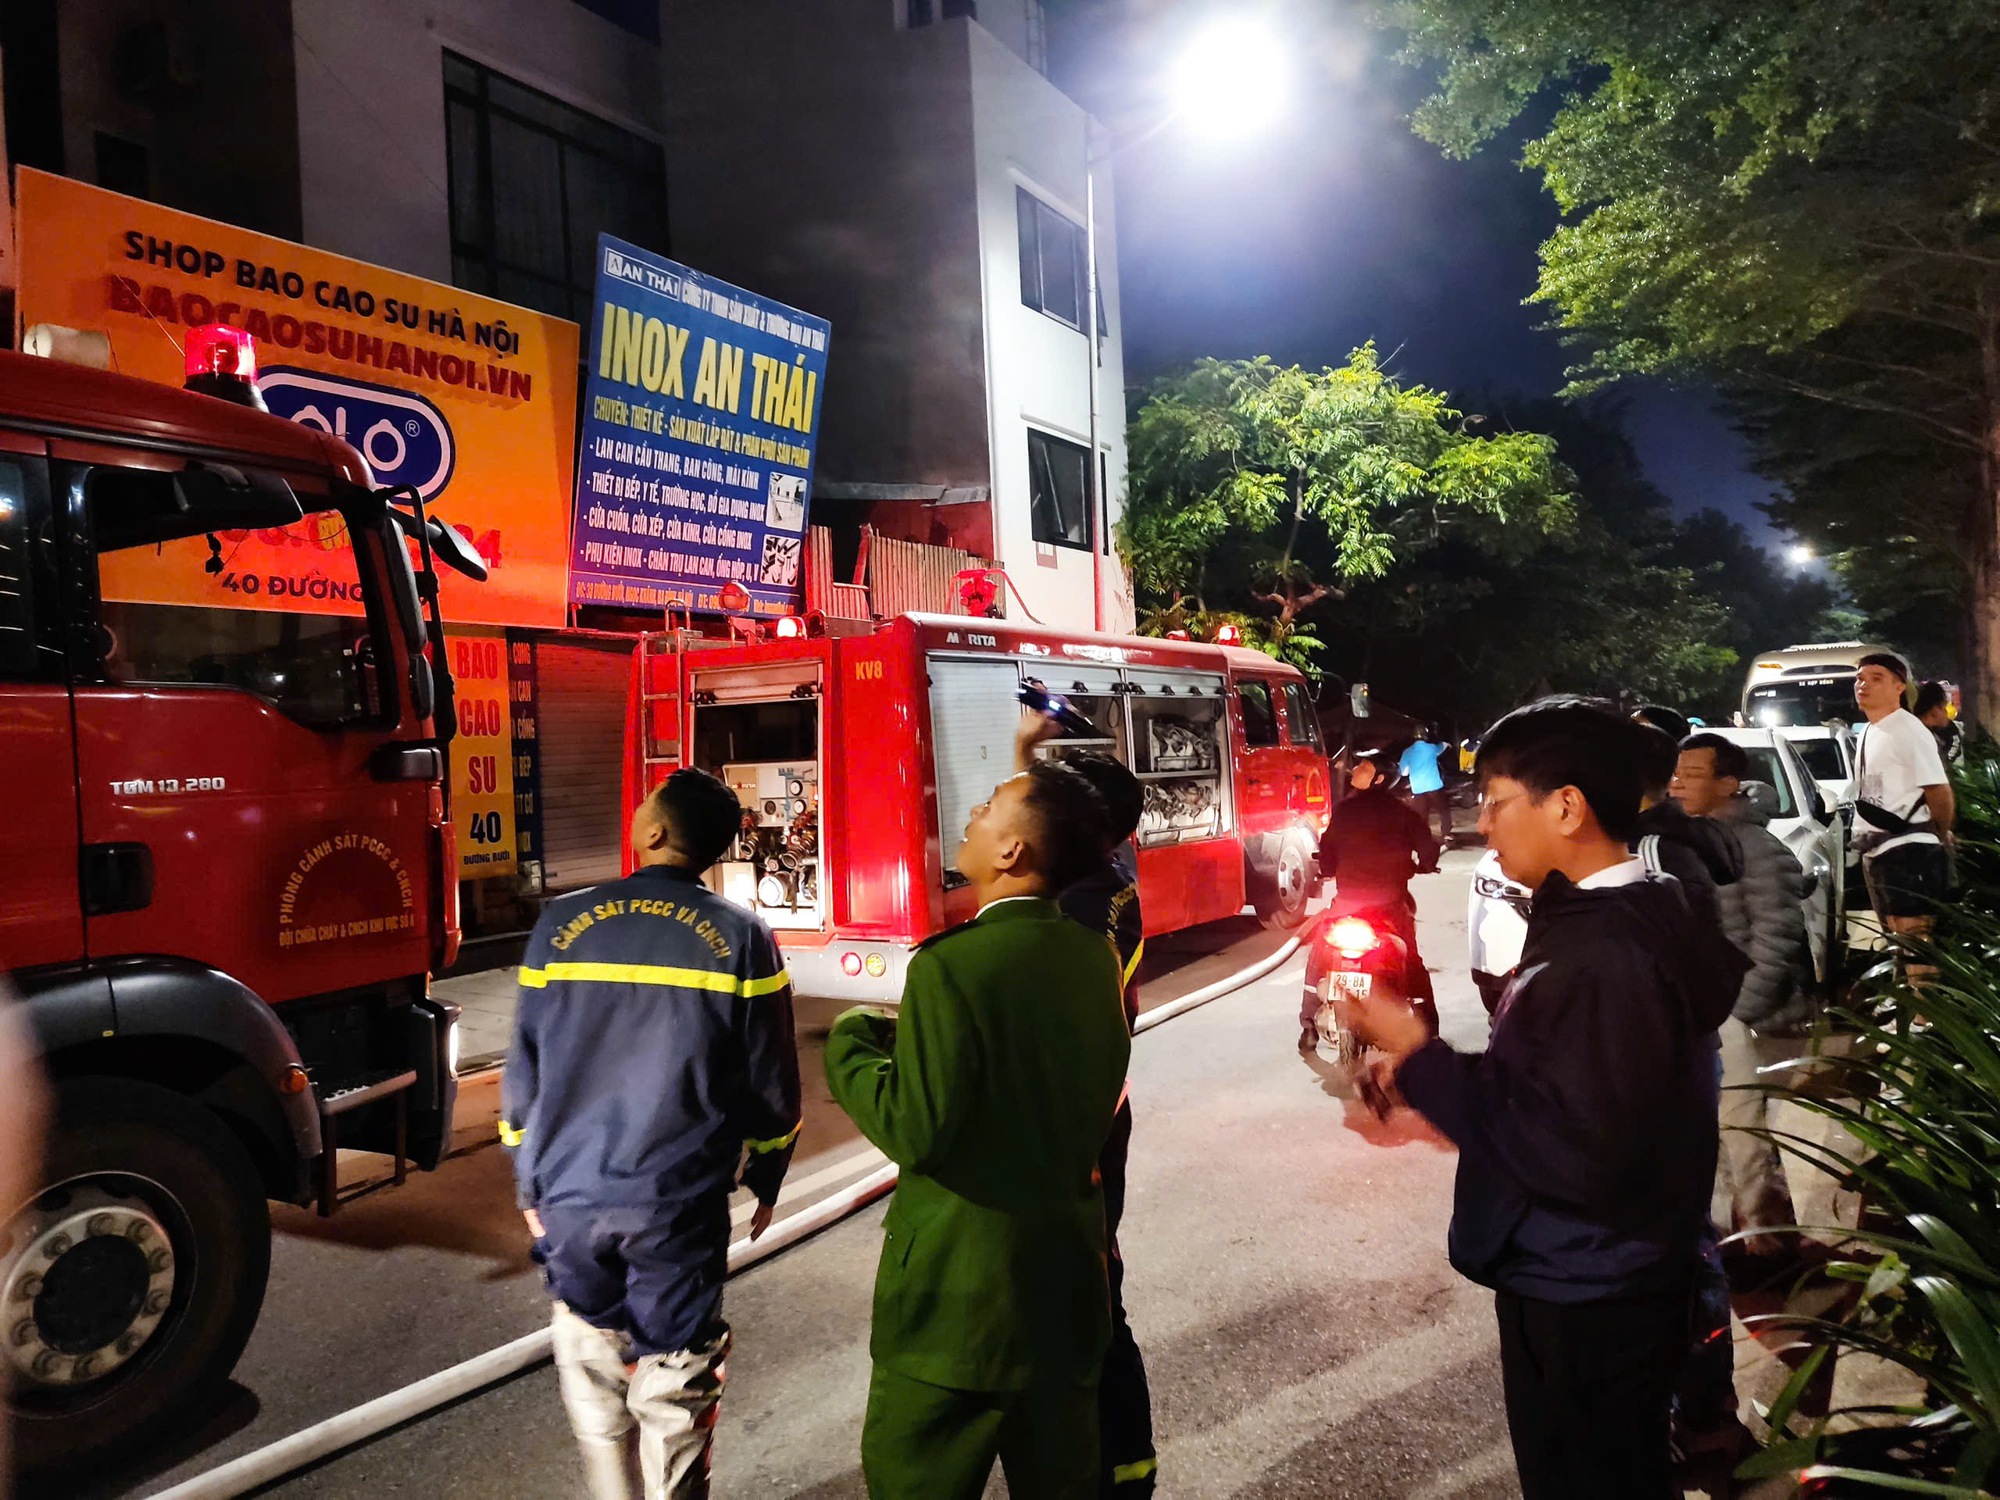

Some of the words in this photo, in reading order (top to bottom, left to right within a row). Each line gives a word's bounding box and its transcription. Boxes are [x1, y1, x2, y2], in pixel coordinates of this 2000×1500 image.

[622, 263, 643, 282] AN
[125, 231, 225, 278] SHOP
[236, 259, 304, 299] BAO
[315, 281, 375, 317] CAO
[385, 298, 419, 329] SU
[428, 308, 466, 342] HÀ
[475, 320, 519, 359] NỘI
[599, 301, 690, 401] INOX
[693, 336, 744, 415] AN
[750, 353, 817, 434] THÁI
[595, 436, 614, 459] LAN
[615, 441, 633, 464] CAN
[634, 440, 652, 468] CẦU
[684, 456, 700, 478] BAN
[592, 468, 614, 495] THIẾT
[614, 476, 624, 501] BỊ
[643, 481, 648, 501] Y
[661, 483, 690, 509] TRƯỜNG
[589, 501, 605, 528] CỬA
[631, 508, 648, 536] CỬA
[666, 514, 682, 540] CỬA
[702, 520, 717, 545] CỬA
[585, 541, 603, 568] PHỤ
[603, 541, 623, 569] KIỆN
[623, 546, 643, 568] INOX
[648, 548, 669, 571] CHÂN
[684, 554, 699, 575] LAN
[222, 572, 260, 596] 40
[946, 632, 997, 647] MRITA
[456, 641, 498, 680] BAO
[855, 660, 883, 680] KV8
[459, 699, 501, 737] CAO
[109, 779, 154, 795] TGM
[157, 777, 226, 792] 13.280
[469, 756, 497, 794] SU
[470, 811, 501, 844] 40
[280, 872, 304, 924] PHÒNG
[299, 841, 332, 872] CẢNH
[334, 830, 358, 850] SÁT
[361, 836, 391, 860] PCCC
[396, 870, 413, 907] CNCH
[629, 899, 675, 918] PCCC
[695, 920, 732, 959] CNCH
